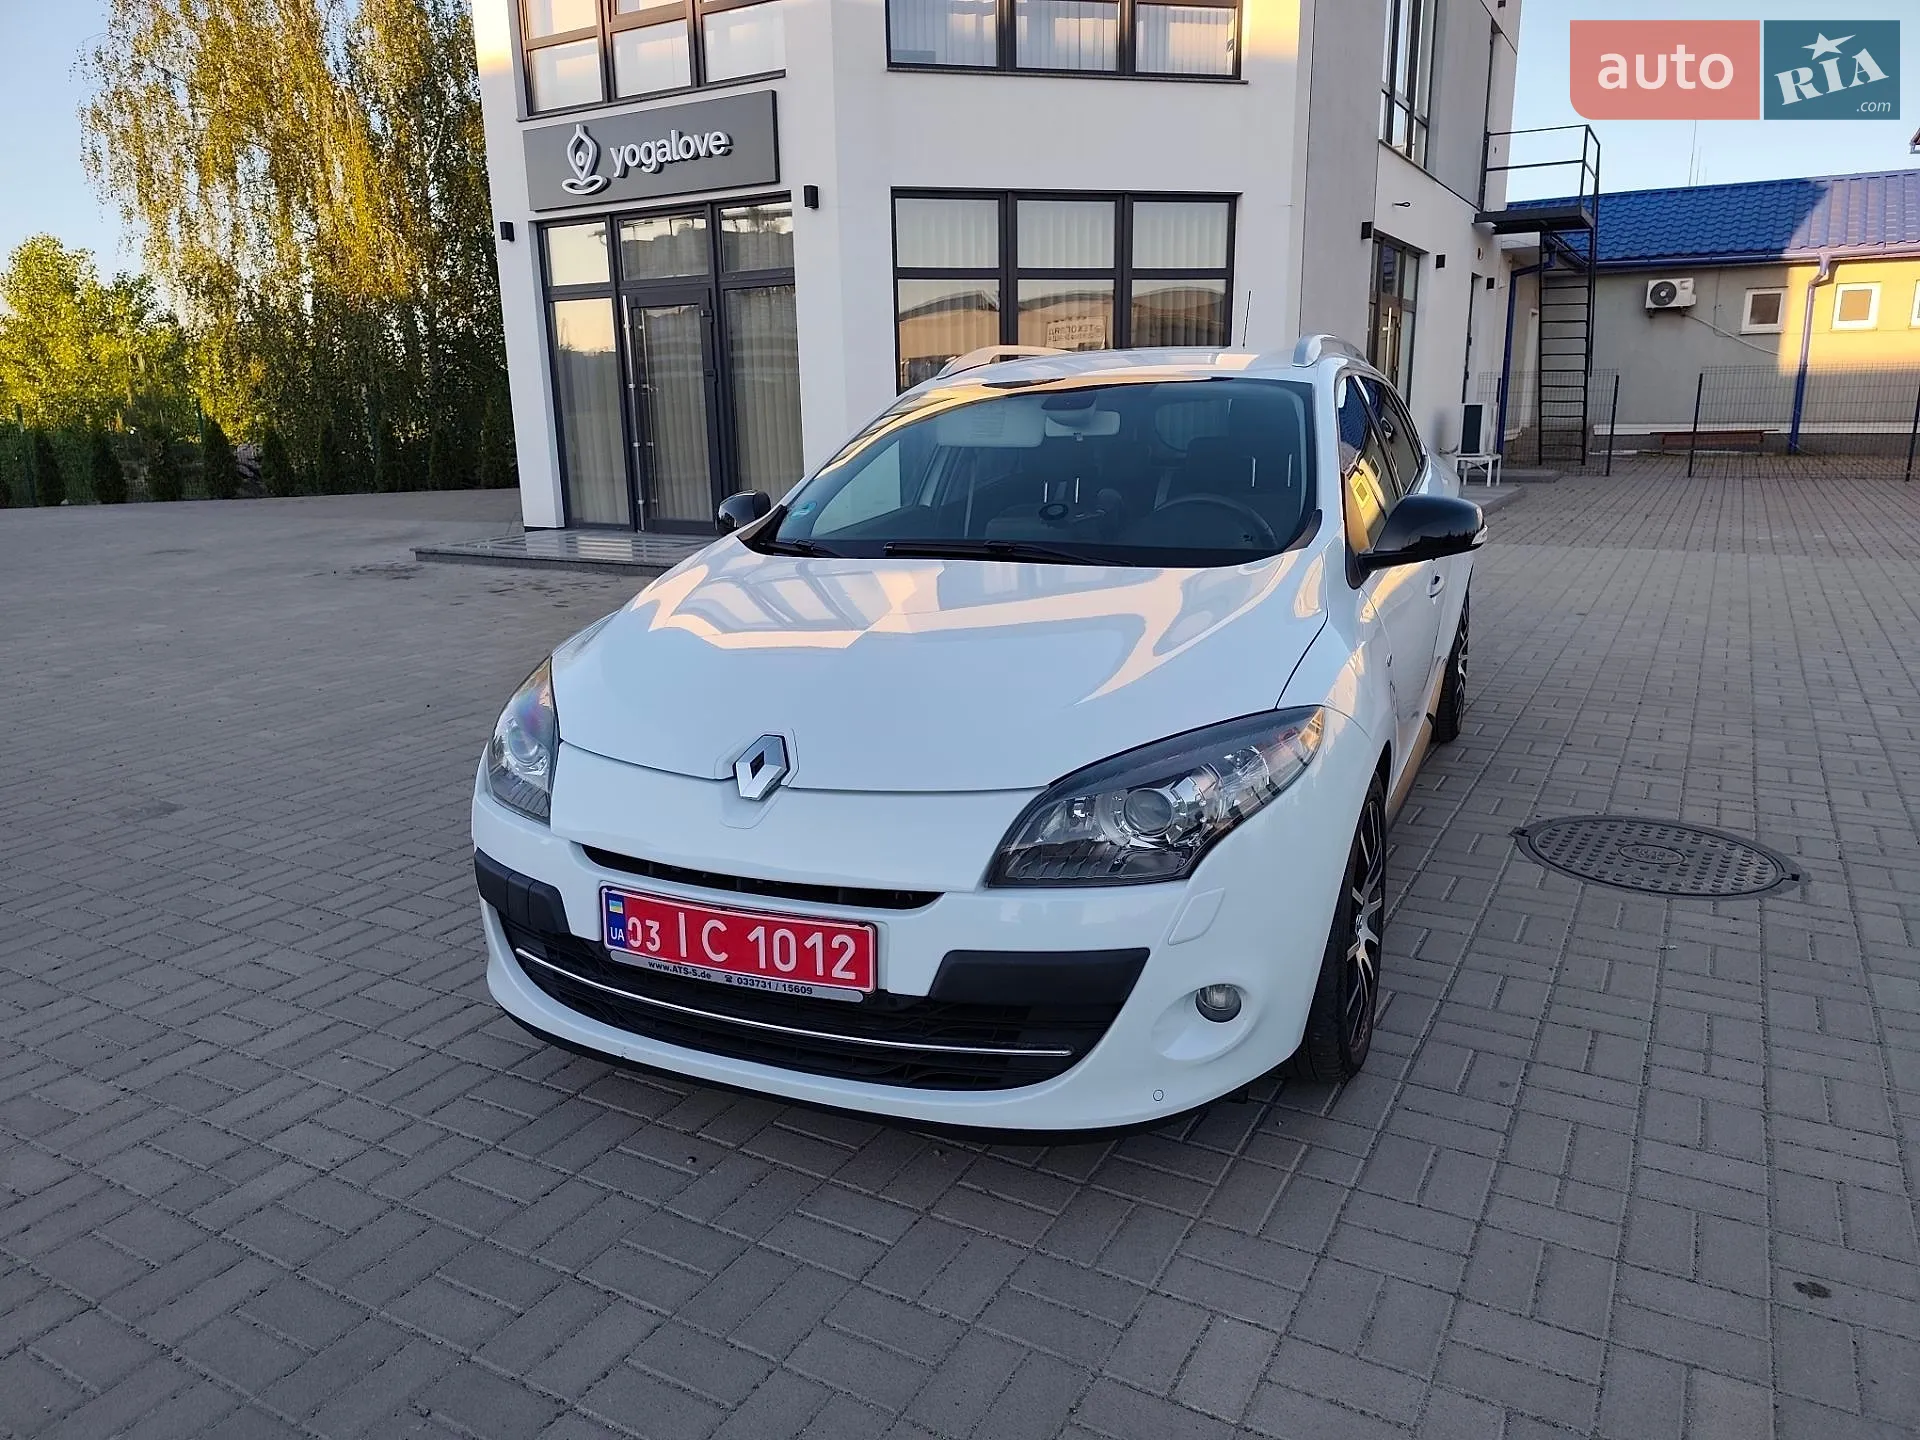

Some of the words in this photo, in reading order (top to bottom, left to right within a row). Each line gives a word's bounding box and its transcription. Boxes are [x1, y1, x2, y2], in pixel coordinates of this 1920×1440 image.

[610, 129, 730, 177] yogalove
[610, 927, 625, 942] UA
[628, 917, 661, 952] 03
[747, 926, 856, 980] 1012
[648, 960, 711, 980] www.ATS-S.de
[736, 976, 772, 990] 033731
[782, 983, 813, 995] 15609
